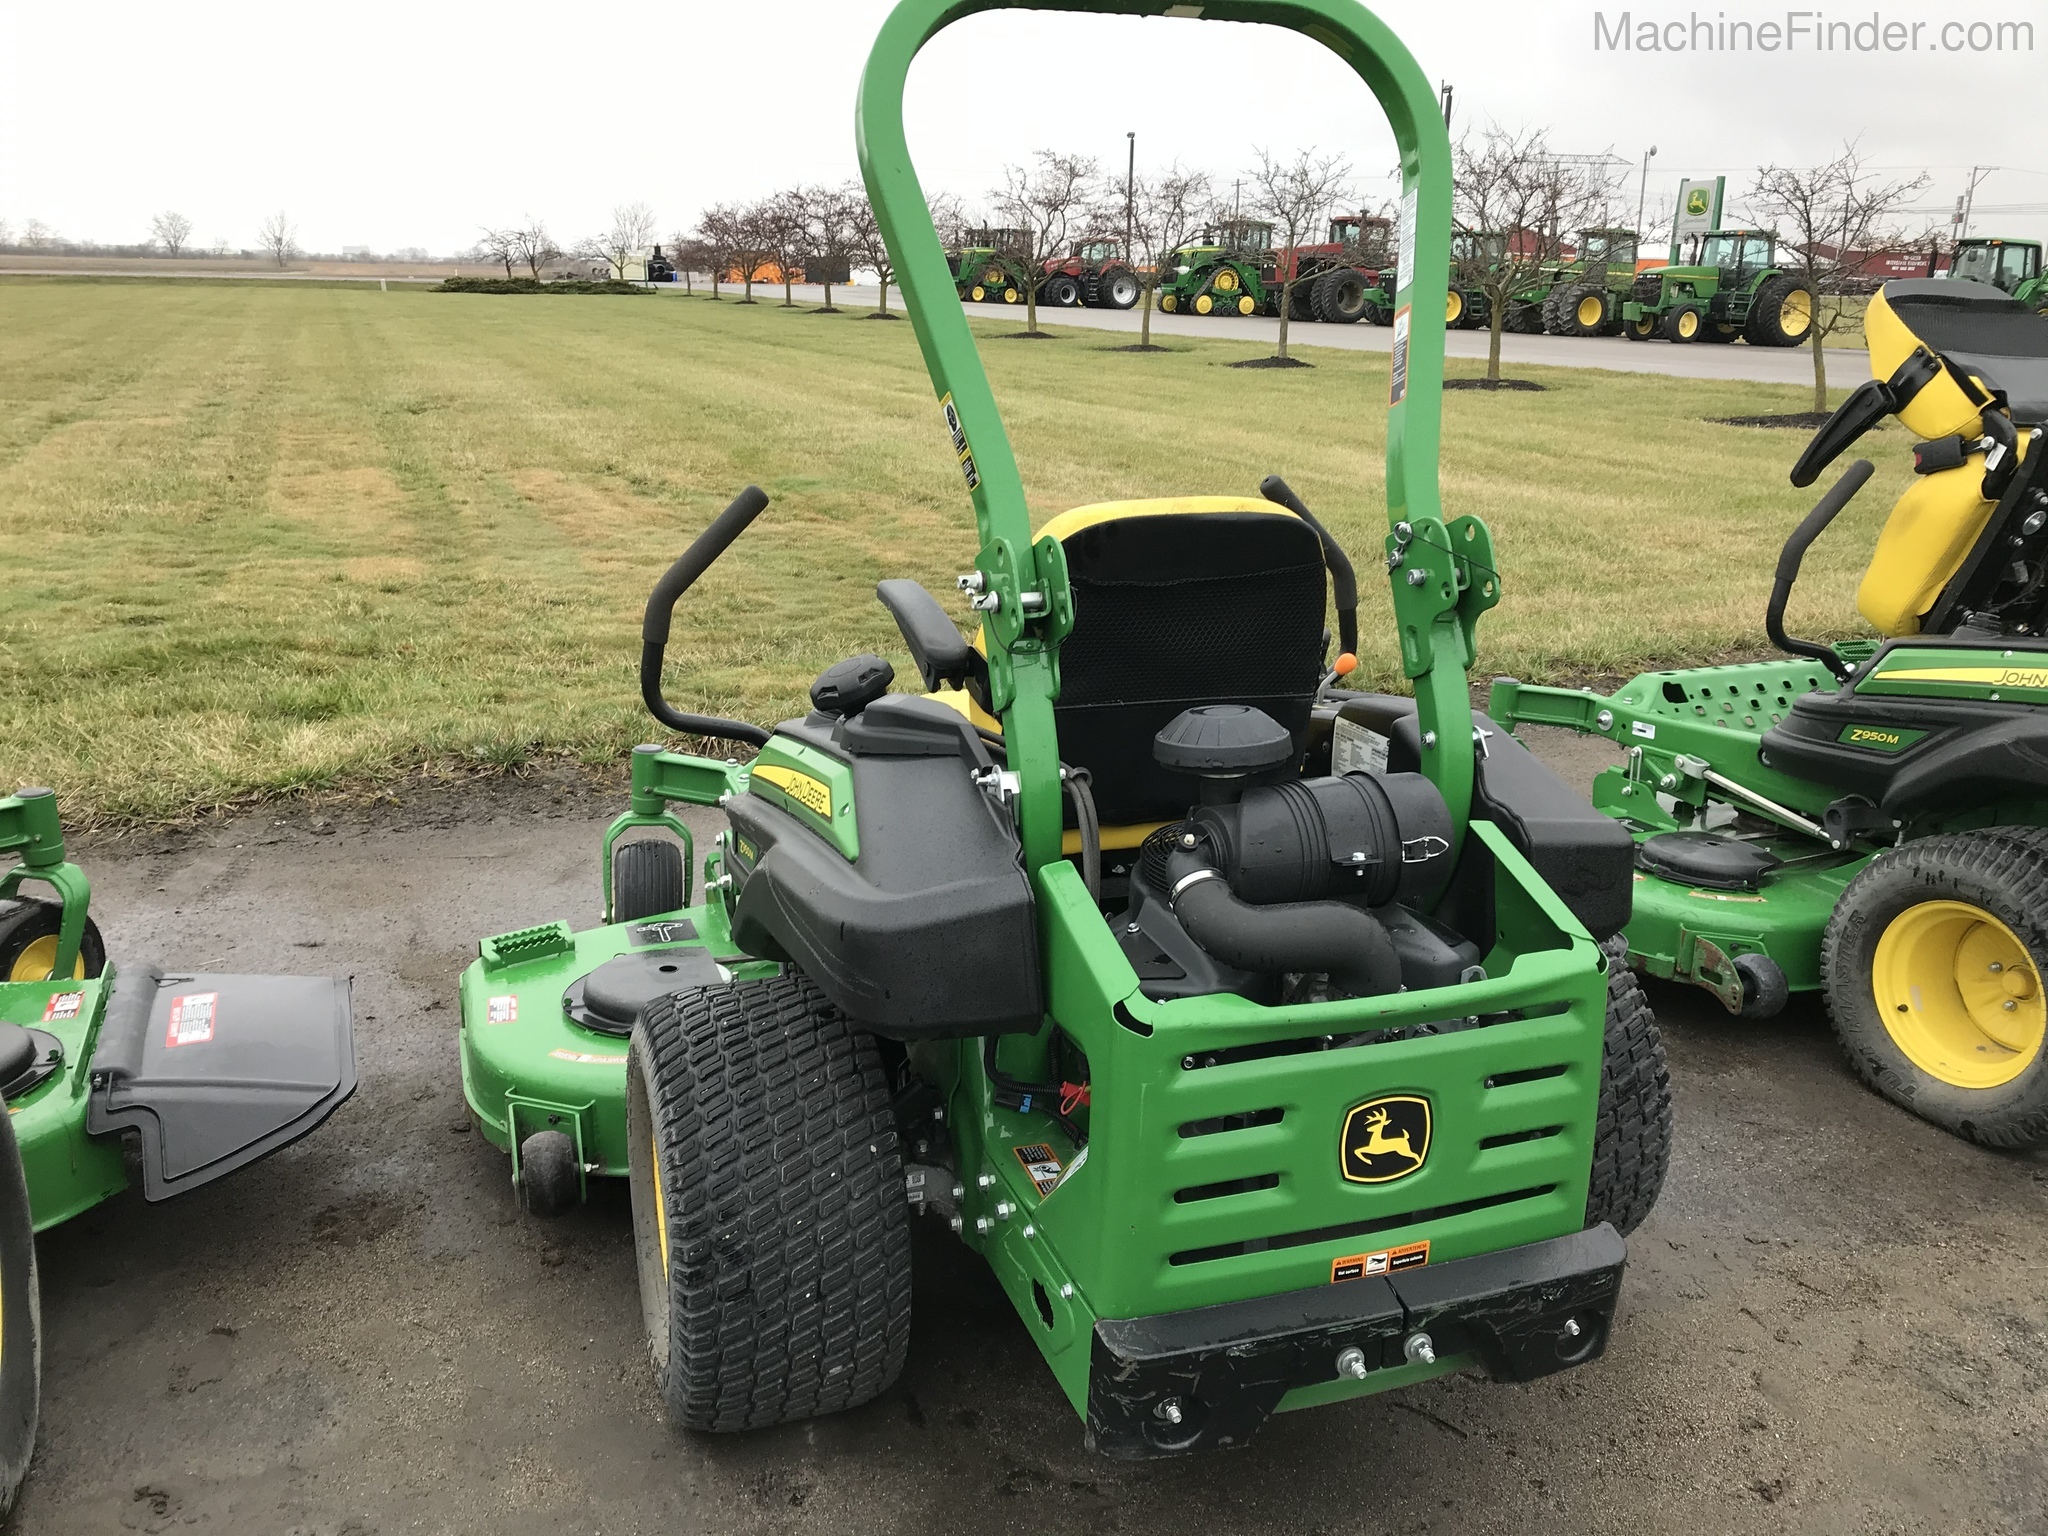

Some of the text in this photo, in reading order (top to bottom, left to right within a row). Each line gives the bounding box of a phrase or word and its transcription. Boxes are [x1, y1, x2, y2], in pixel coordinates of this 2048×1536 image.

[1994, 669, 2048, 686] JOHN
[1850, 729, 1900, 745] Z950M
[1836, 908, 1868, 1035] MASTER
